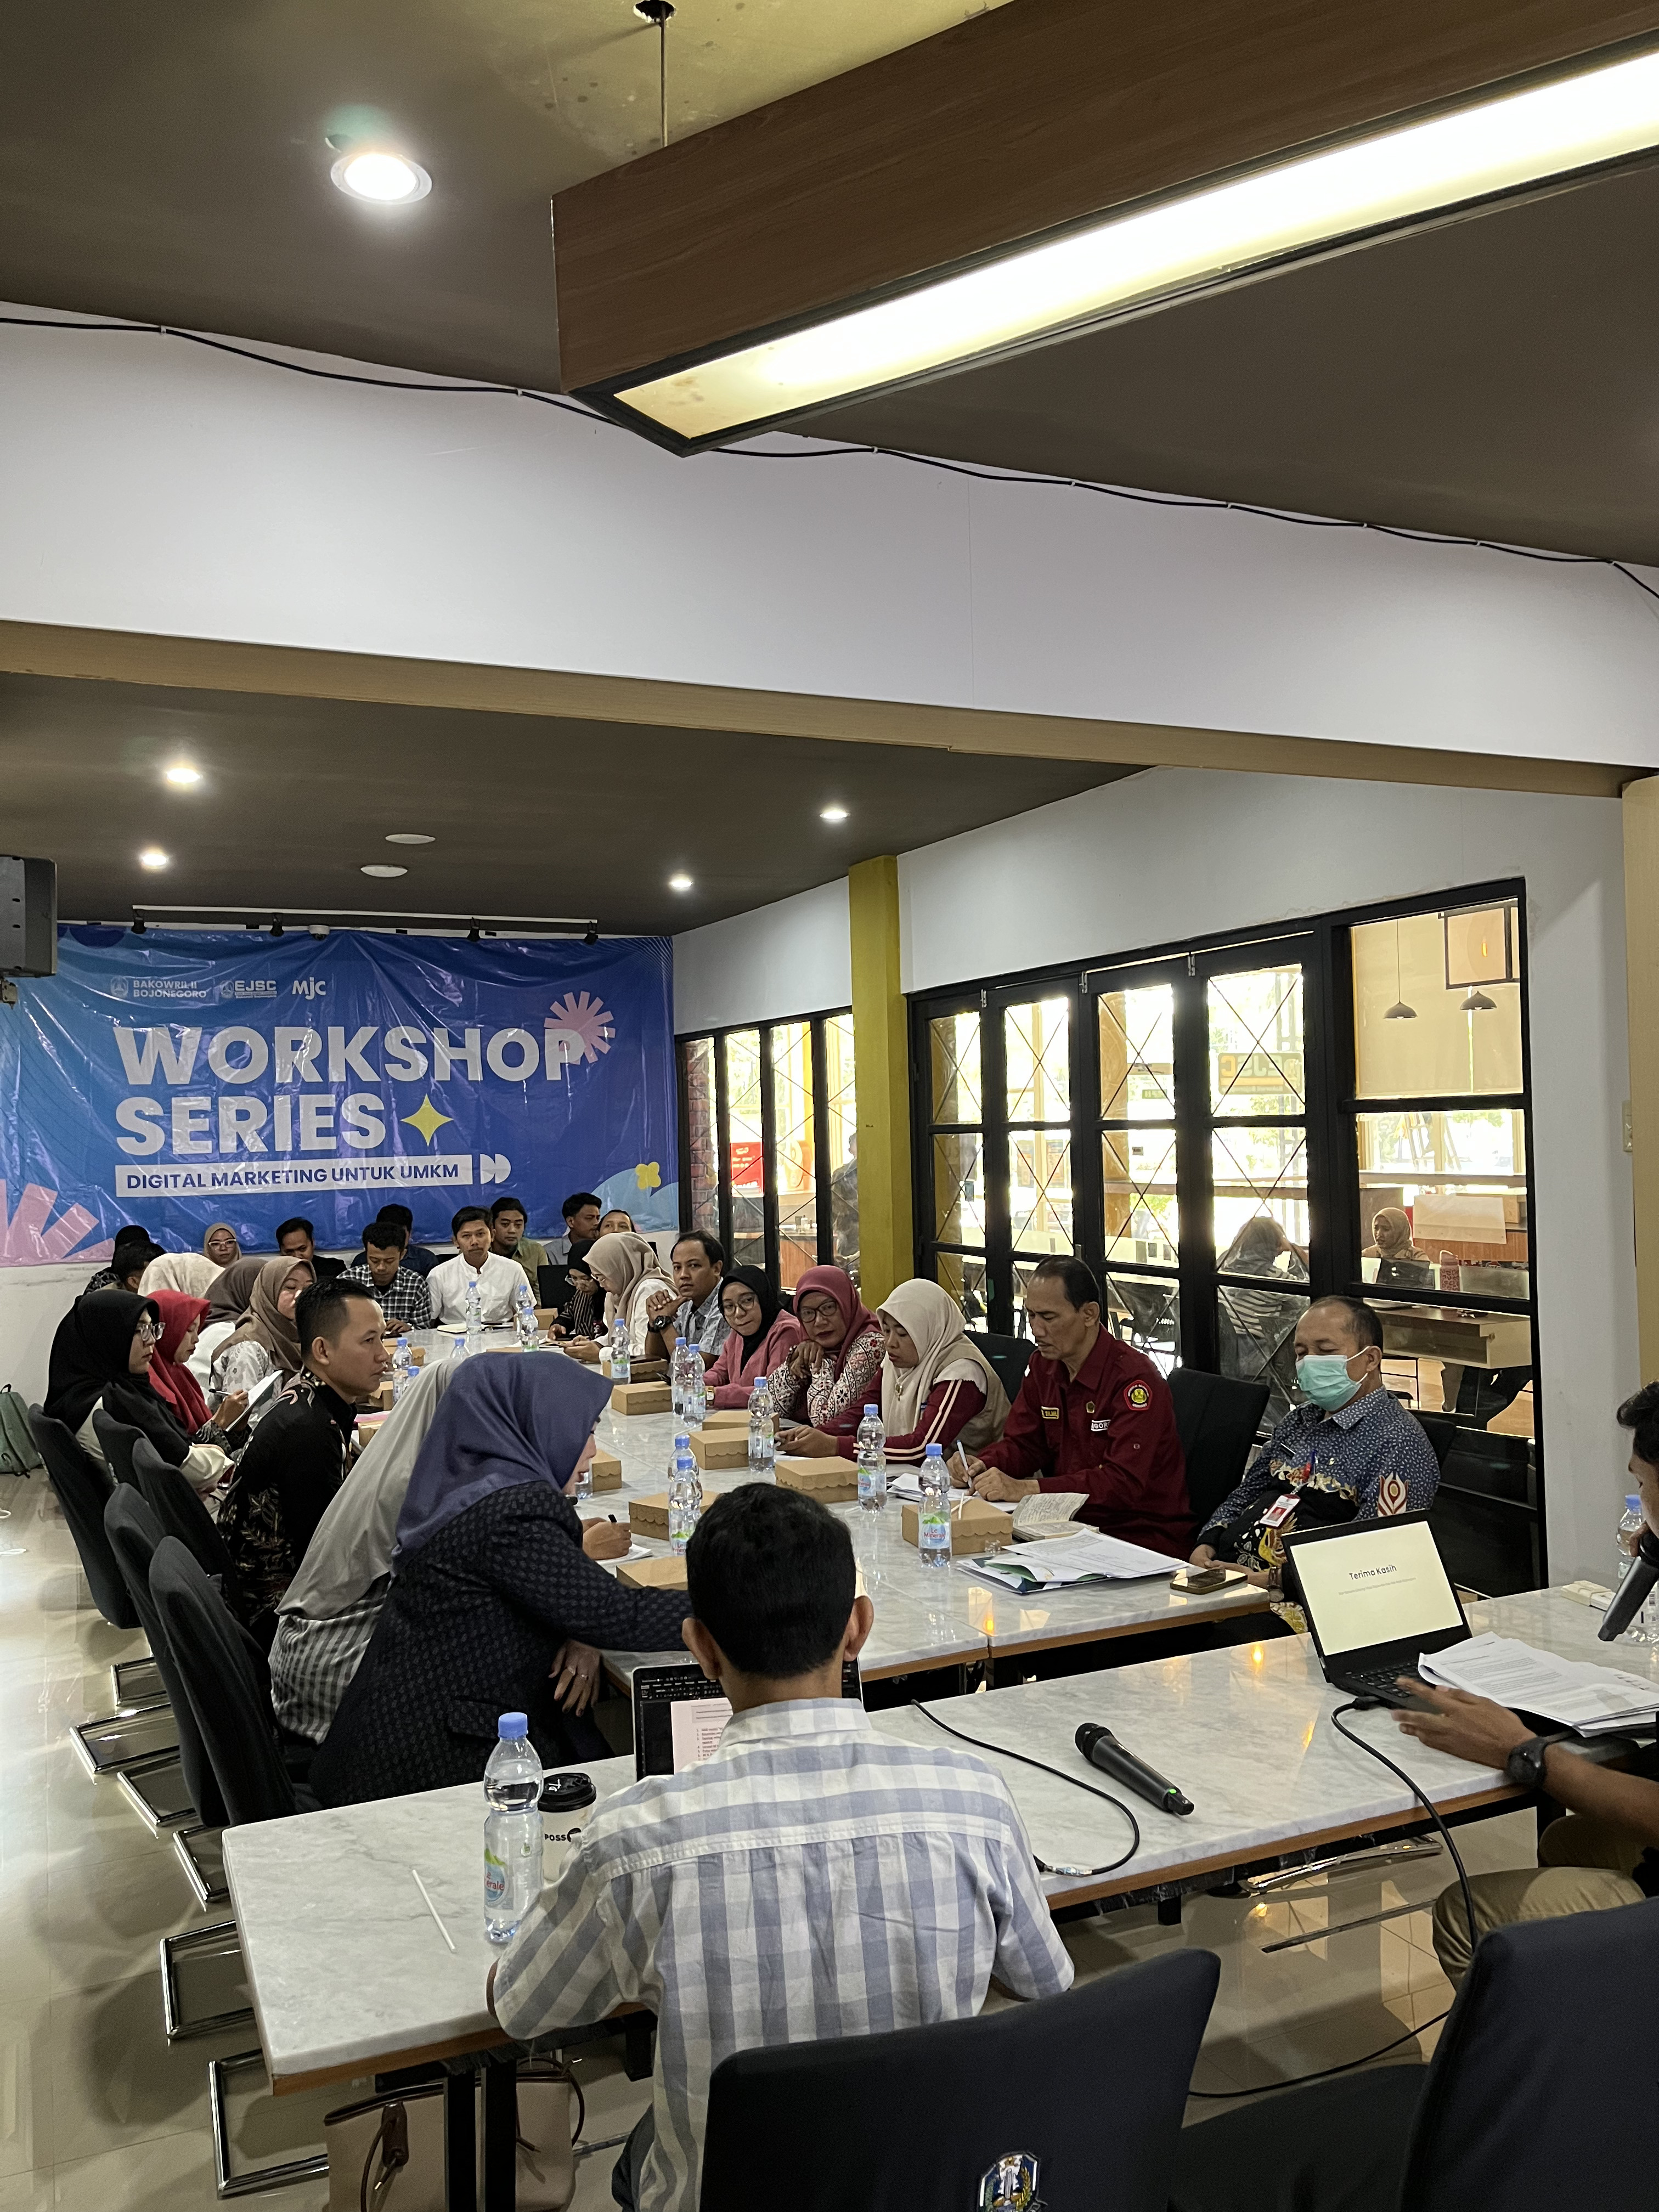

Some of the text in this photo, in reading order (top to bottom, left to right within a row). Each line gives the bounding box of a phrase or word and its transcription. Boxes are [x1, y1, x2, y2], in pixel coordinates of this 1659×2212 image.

[133, 989, 207, 998] BOJONEGORO
[235, 980, 276, 991] EJSC
[113, 1026, 585, 1085] WORKSHOP
[115, 1092, 386, 1156] SERIES
[127, 1164, 458, 1189] DIGITAL MARKETING UNTUK UMKM
[1348, 1564, 1397, 1580] Terima Kasih
